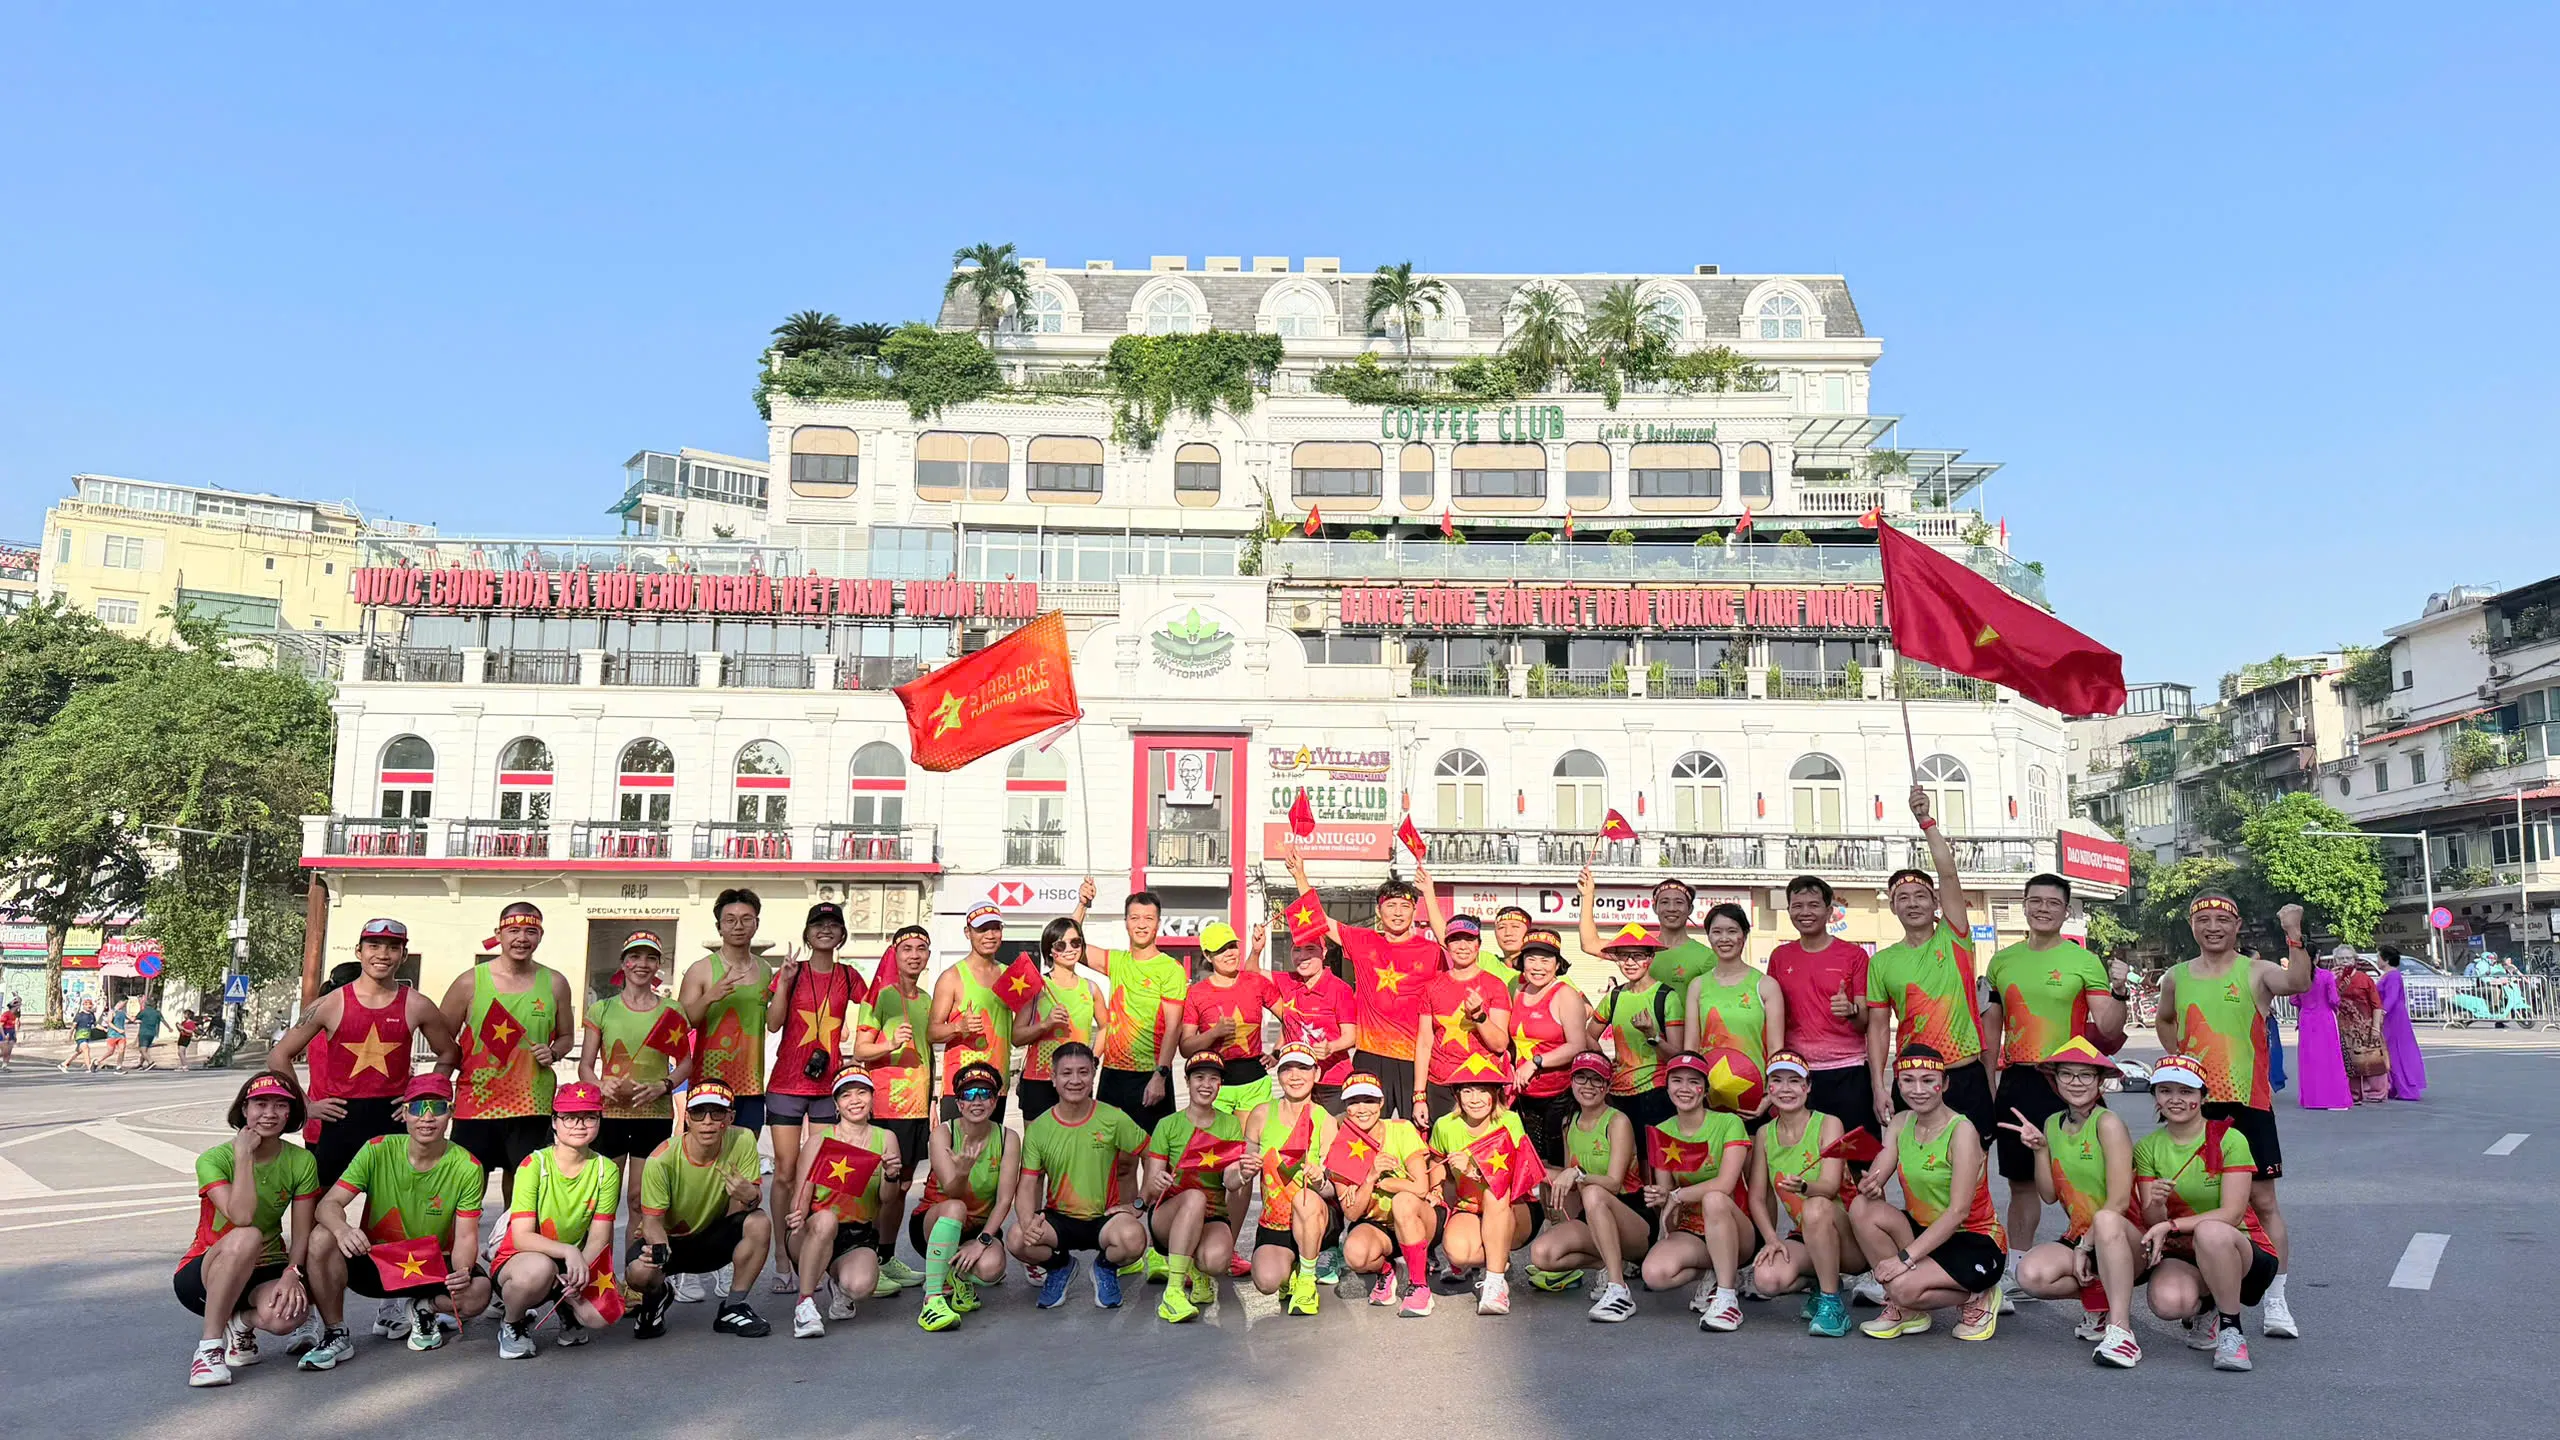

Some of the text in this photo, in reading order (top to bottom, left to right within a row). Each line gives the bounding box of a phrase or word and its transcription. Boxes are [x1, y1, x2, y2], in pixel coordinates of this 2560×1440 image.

[1382, 406, 1565, 440] COFFEE CLUB
[354, 557, 424, 606] NƯỚC
[429, 559, 496, 614] CỘNG
[556, 563, 590, 609] XÃ
[596, 562, 636, 617] HỘI
[783, 567, 833, 621] VIỆT
[837, 578, 892, 617] NAM
[904, 571, 975, 618] MUÔN
[983, 572, 1038, 619] NĂM
[1414, 579, 1476, 631] CỘNG
[1540, 580, 1590, 632] VIỆT
[1596, 589, 1650, 626] NAM
[1655, 589, 1735, 632] QUANG
[1744, 590, 1800, 627] VINH
[1806, 582, 1876, 627] MUÔN
[969, 658, 1049, 706] STARLAKE
[970, 678, 1050, 720] running club
[1272, 786, 1387, 809] COFEE CLUB
[1316, 832, 1344, 845] NIU
[1344, 832, 1377, 845] GUO
[1039, 888, 1077, 900] HSBC
[107, 943, 157, 953] THE NOT
[1923, 1059, 1935, 1070] VIỆT
[2163, 1057, 2174, 1066] YÊU
[2187, 1060, 2198, 1073] VIỆT
